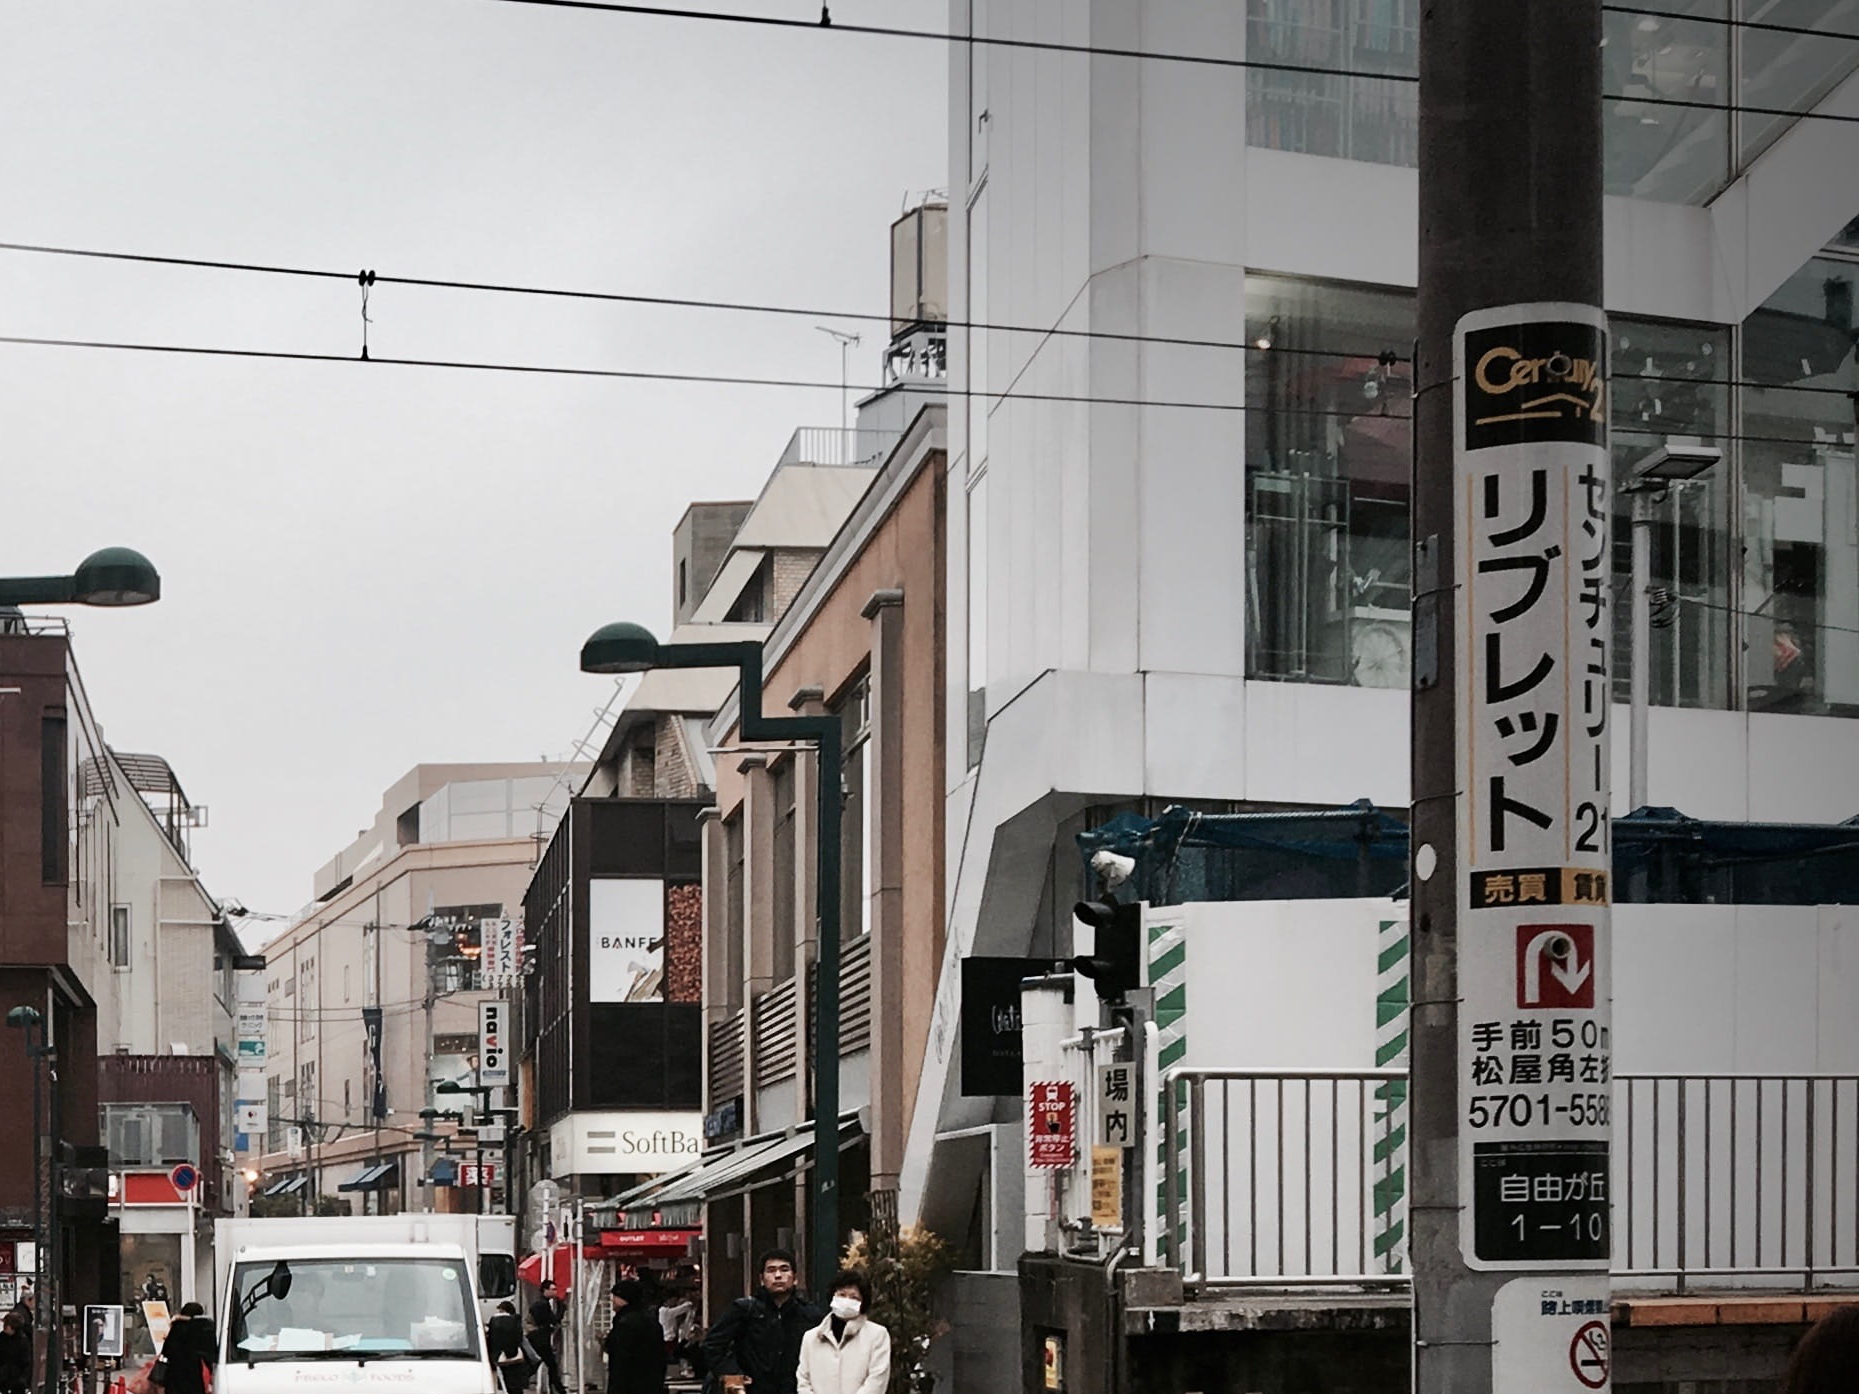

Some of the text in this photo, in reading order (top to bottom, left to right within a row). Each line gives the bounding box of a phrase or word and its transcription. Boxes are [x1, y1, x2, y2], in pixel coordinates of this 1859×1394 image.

[1478, 469, 1562, 852] リブレット
[1485, 873, 1547, 904] 売買
[486, 1007, 504, 1068] navio
[1038, 1102, 1066, 1112] STOP
[1105, 1068, 1129, 1144] 場内
[622, 1130, 701, 1155] SoftBa
[1501, 1171, 1605, 1202] 自由が丘
